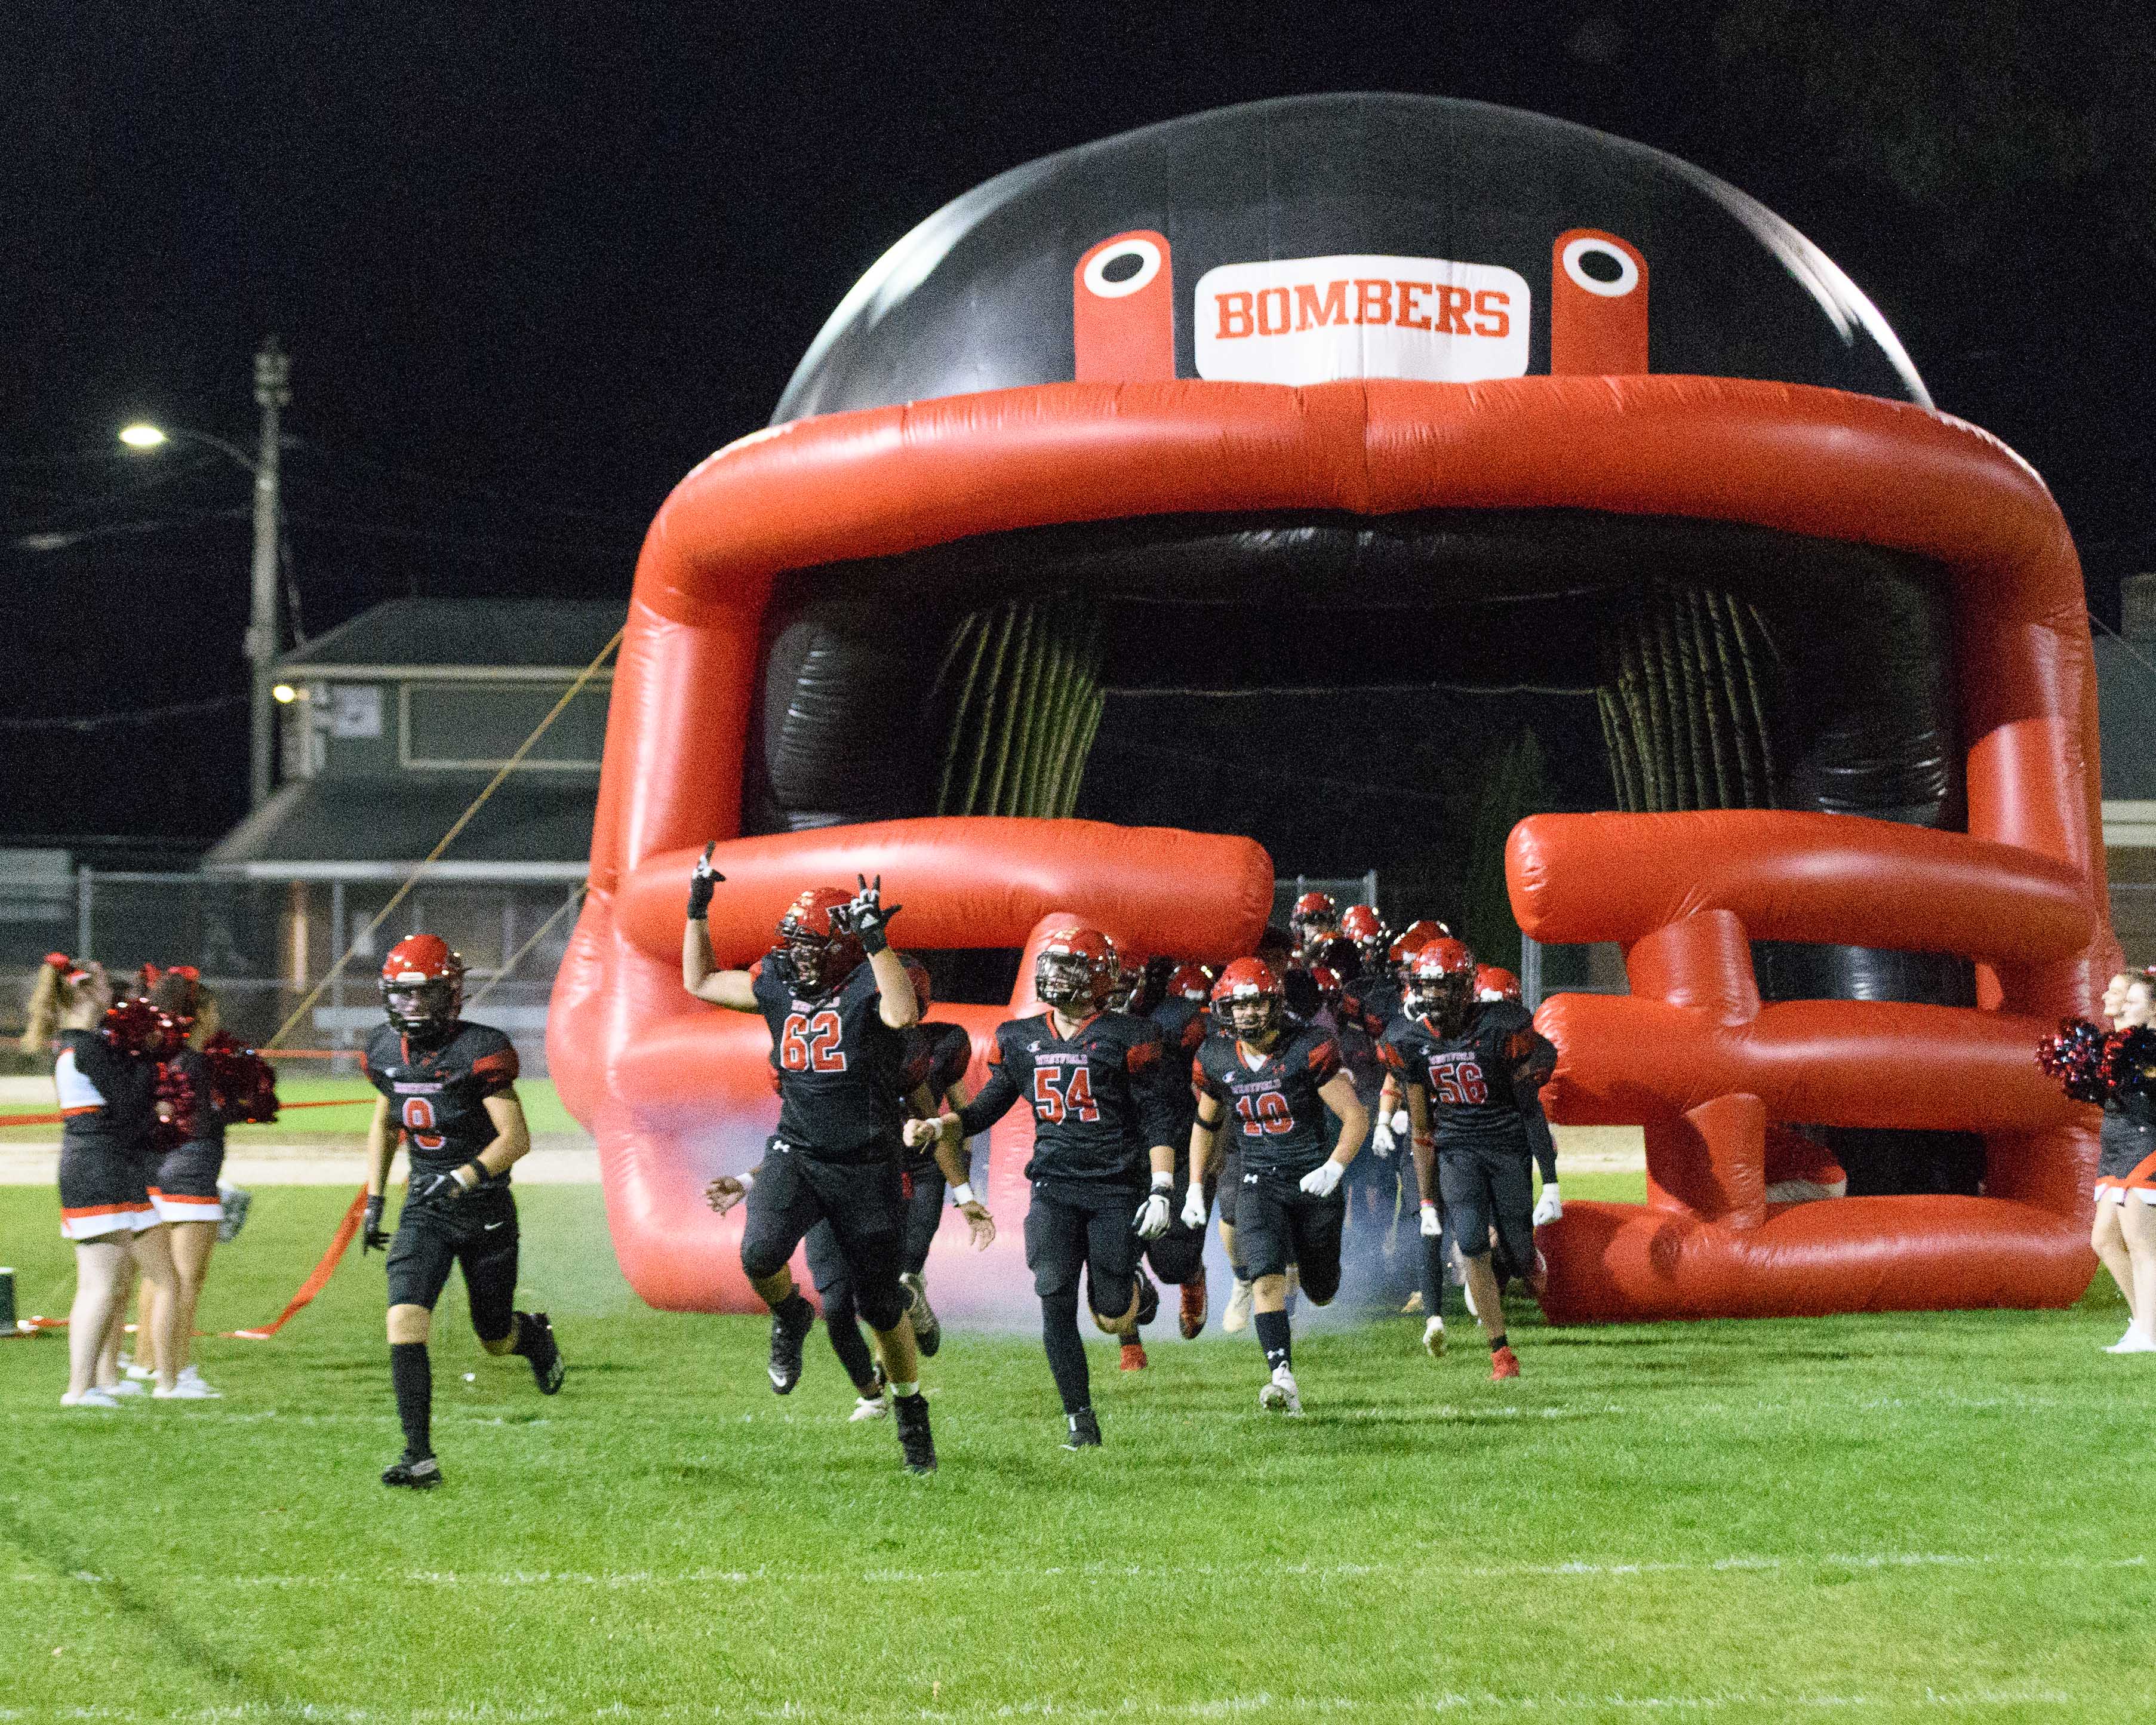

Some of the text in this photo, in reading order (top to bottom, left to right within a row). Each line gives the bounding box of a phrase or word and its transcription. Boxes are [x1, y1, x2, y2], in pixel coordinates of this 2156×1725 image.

[1215, 279, 1509, 339] BOMBERS
[780, 1010, 847, 1072] 62
[1034, 1066, 1100, 1125] 54
[1428, 1062, 1487, 1104] 56
[1236, 1091, 1294, 1136] 10
